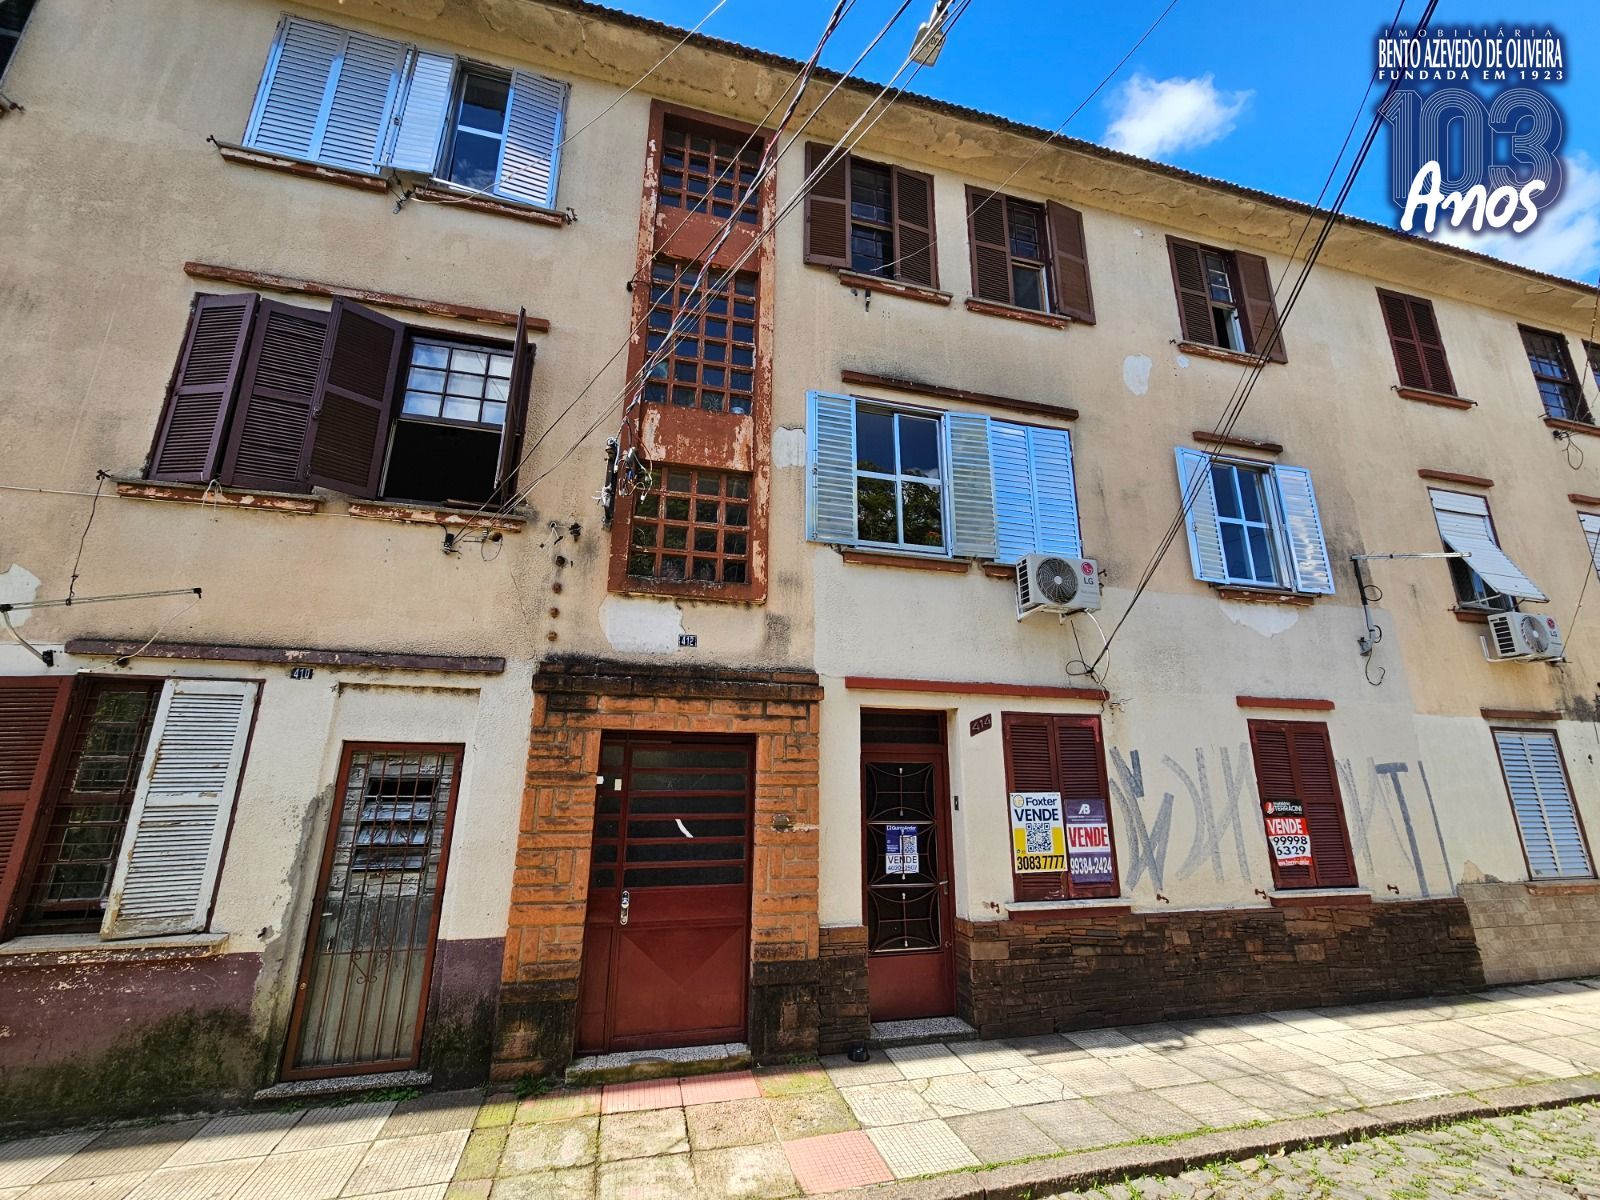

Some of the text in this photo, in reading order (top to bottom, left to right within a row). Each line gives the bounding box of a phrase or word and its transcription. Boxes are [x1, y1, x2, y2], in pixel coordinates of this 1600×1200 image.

[1083, 577, 1094, 585] LG
[293, 668, 311, 679] 410
[971, 716, 991, 730] 414
[1025, 797, 1058, 807] Foxter
[1014, 808, 1060, 822] VENDE
[1266, 818, 1304, 835] VENDE
[1068, 826, 1109, 848] VENDE
[1273, 835, 1308, 846] 99998
[1276, 845, 1307, 856] 6329
[1070, 856, 1113, 875] 99384-2424
